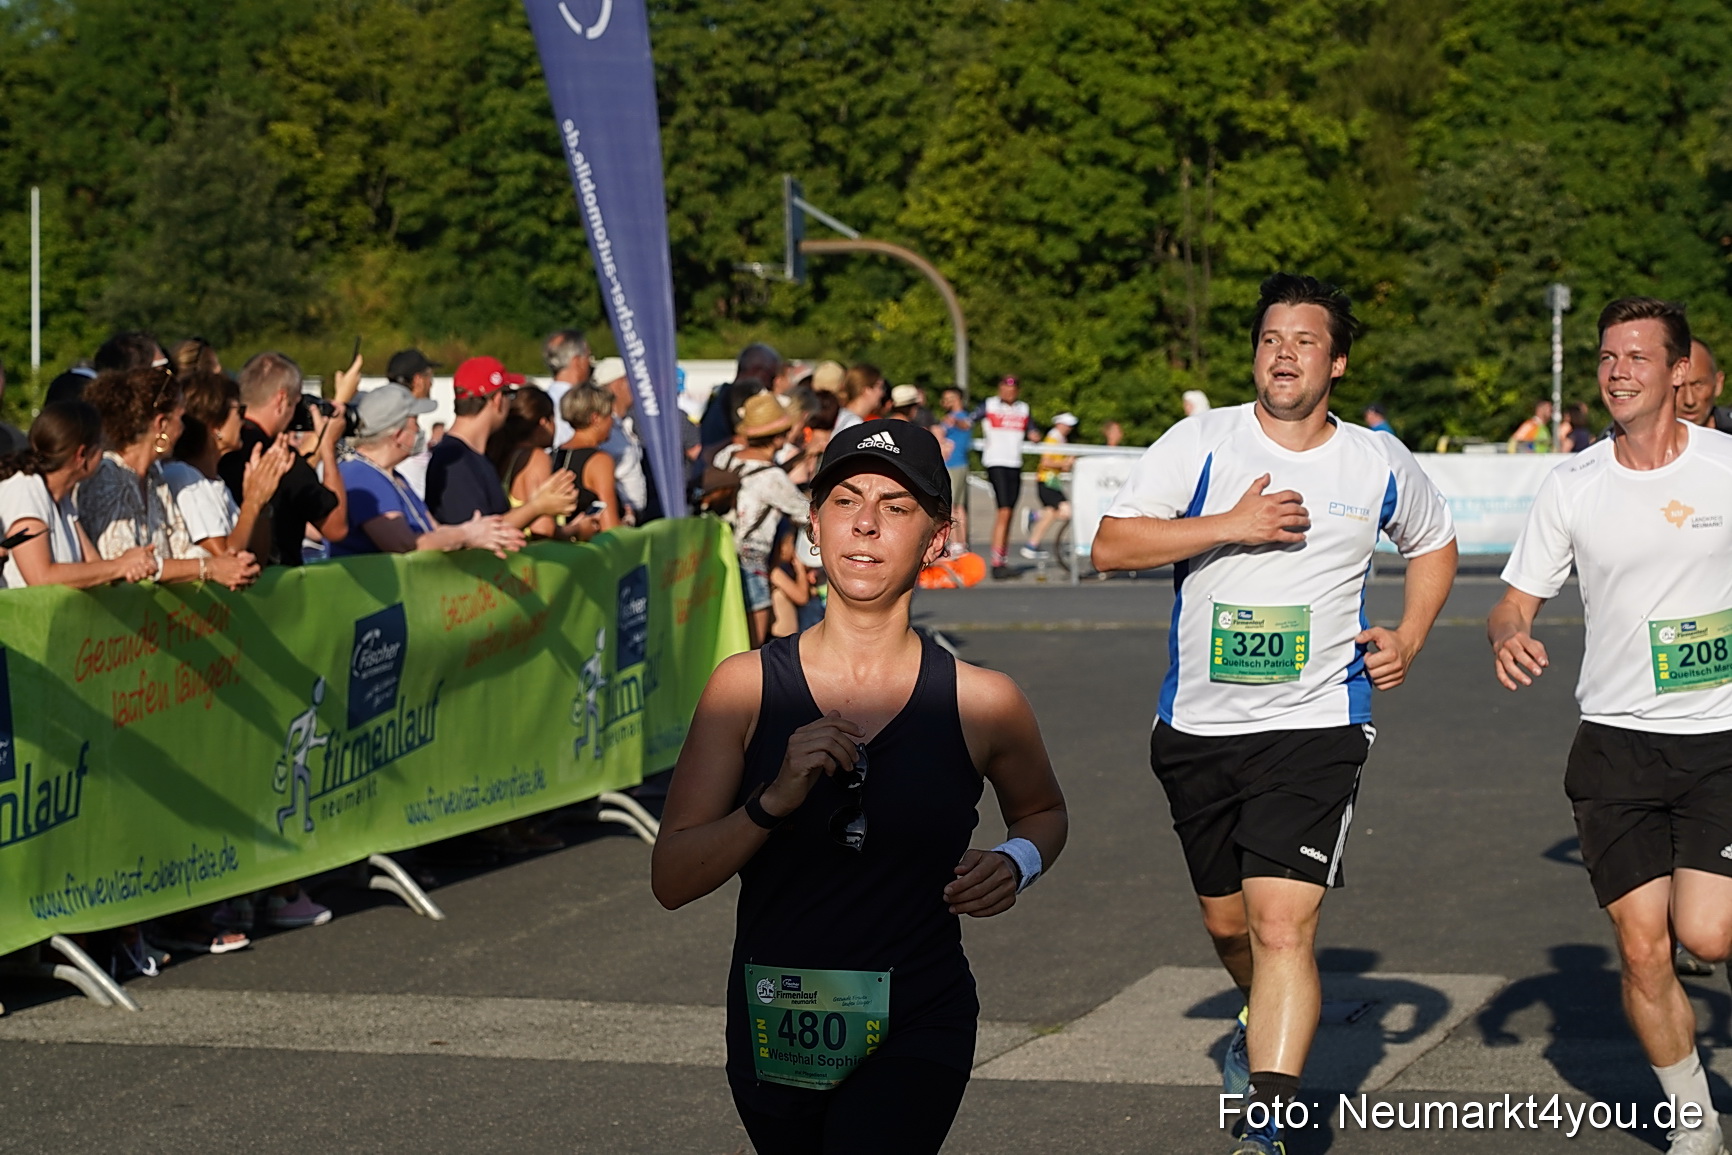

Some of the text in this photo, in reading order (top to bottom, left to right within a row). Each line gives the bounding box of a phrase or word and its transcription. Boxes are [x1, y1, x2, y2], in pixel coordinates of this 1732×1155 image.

[857, 440, 900, 454] adidas
[1214, 637, 1223, 665] RUN
[1232, 631, 1284, 657] 320
[1295, 635, 1305, 671] 2022
[1678, 637, 1728, 668] 208
[1222, 657, 1295, 669] Queitsch Patrick
[1657, 653, 1669, 680] RUN
[1670, 667, 1712, 679] Queitsch
[322, 680, 445, 791] firmenlauf
[320, 783, 378, 821] neumarkt
[776, 991, 818, 1000] Firmenlauf
[756, 1018, 769, 1058] RUN
[777, 1009, 847, 1051] 480
[769, 1048, 814, 1067] Westphal
